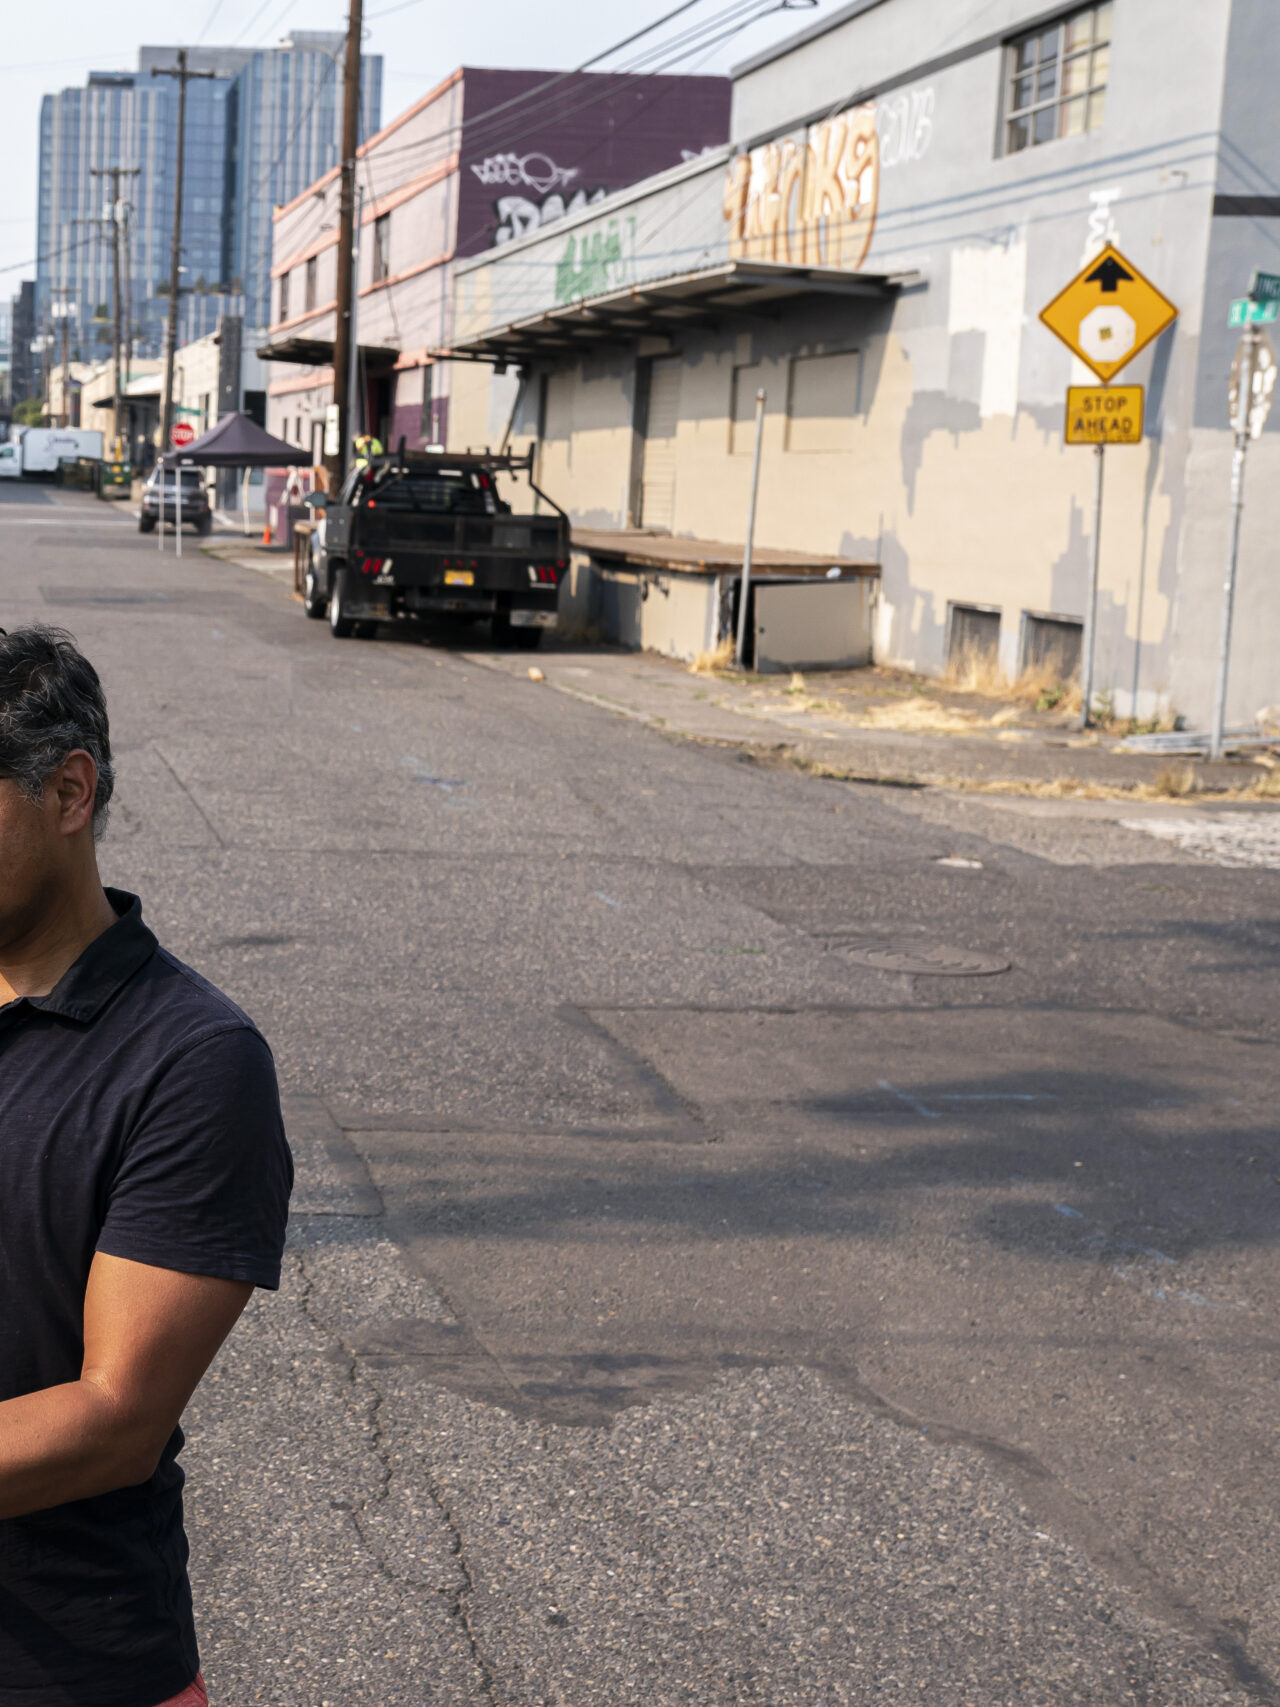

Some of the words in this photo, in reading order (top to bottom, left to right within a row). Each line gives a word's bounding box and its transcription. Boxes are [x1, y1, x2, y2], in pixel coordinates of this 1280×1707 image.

[1083, 396, 1128, 412] STOP
[1074, 417, 1133, 434] AHEAD
[172, 429, 194, 441] STOP
